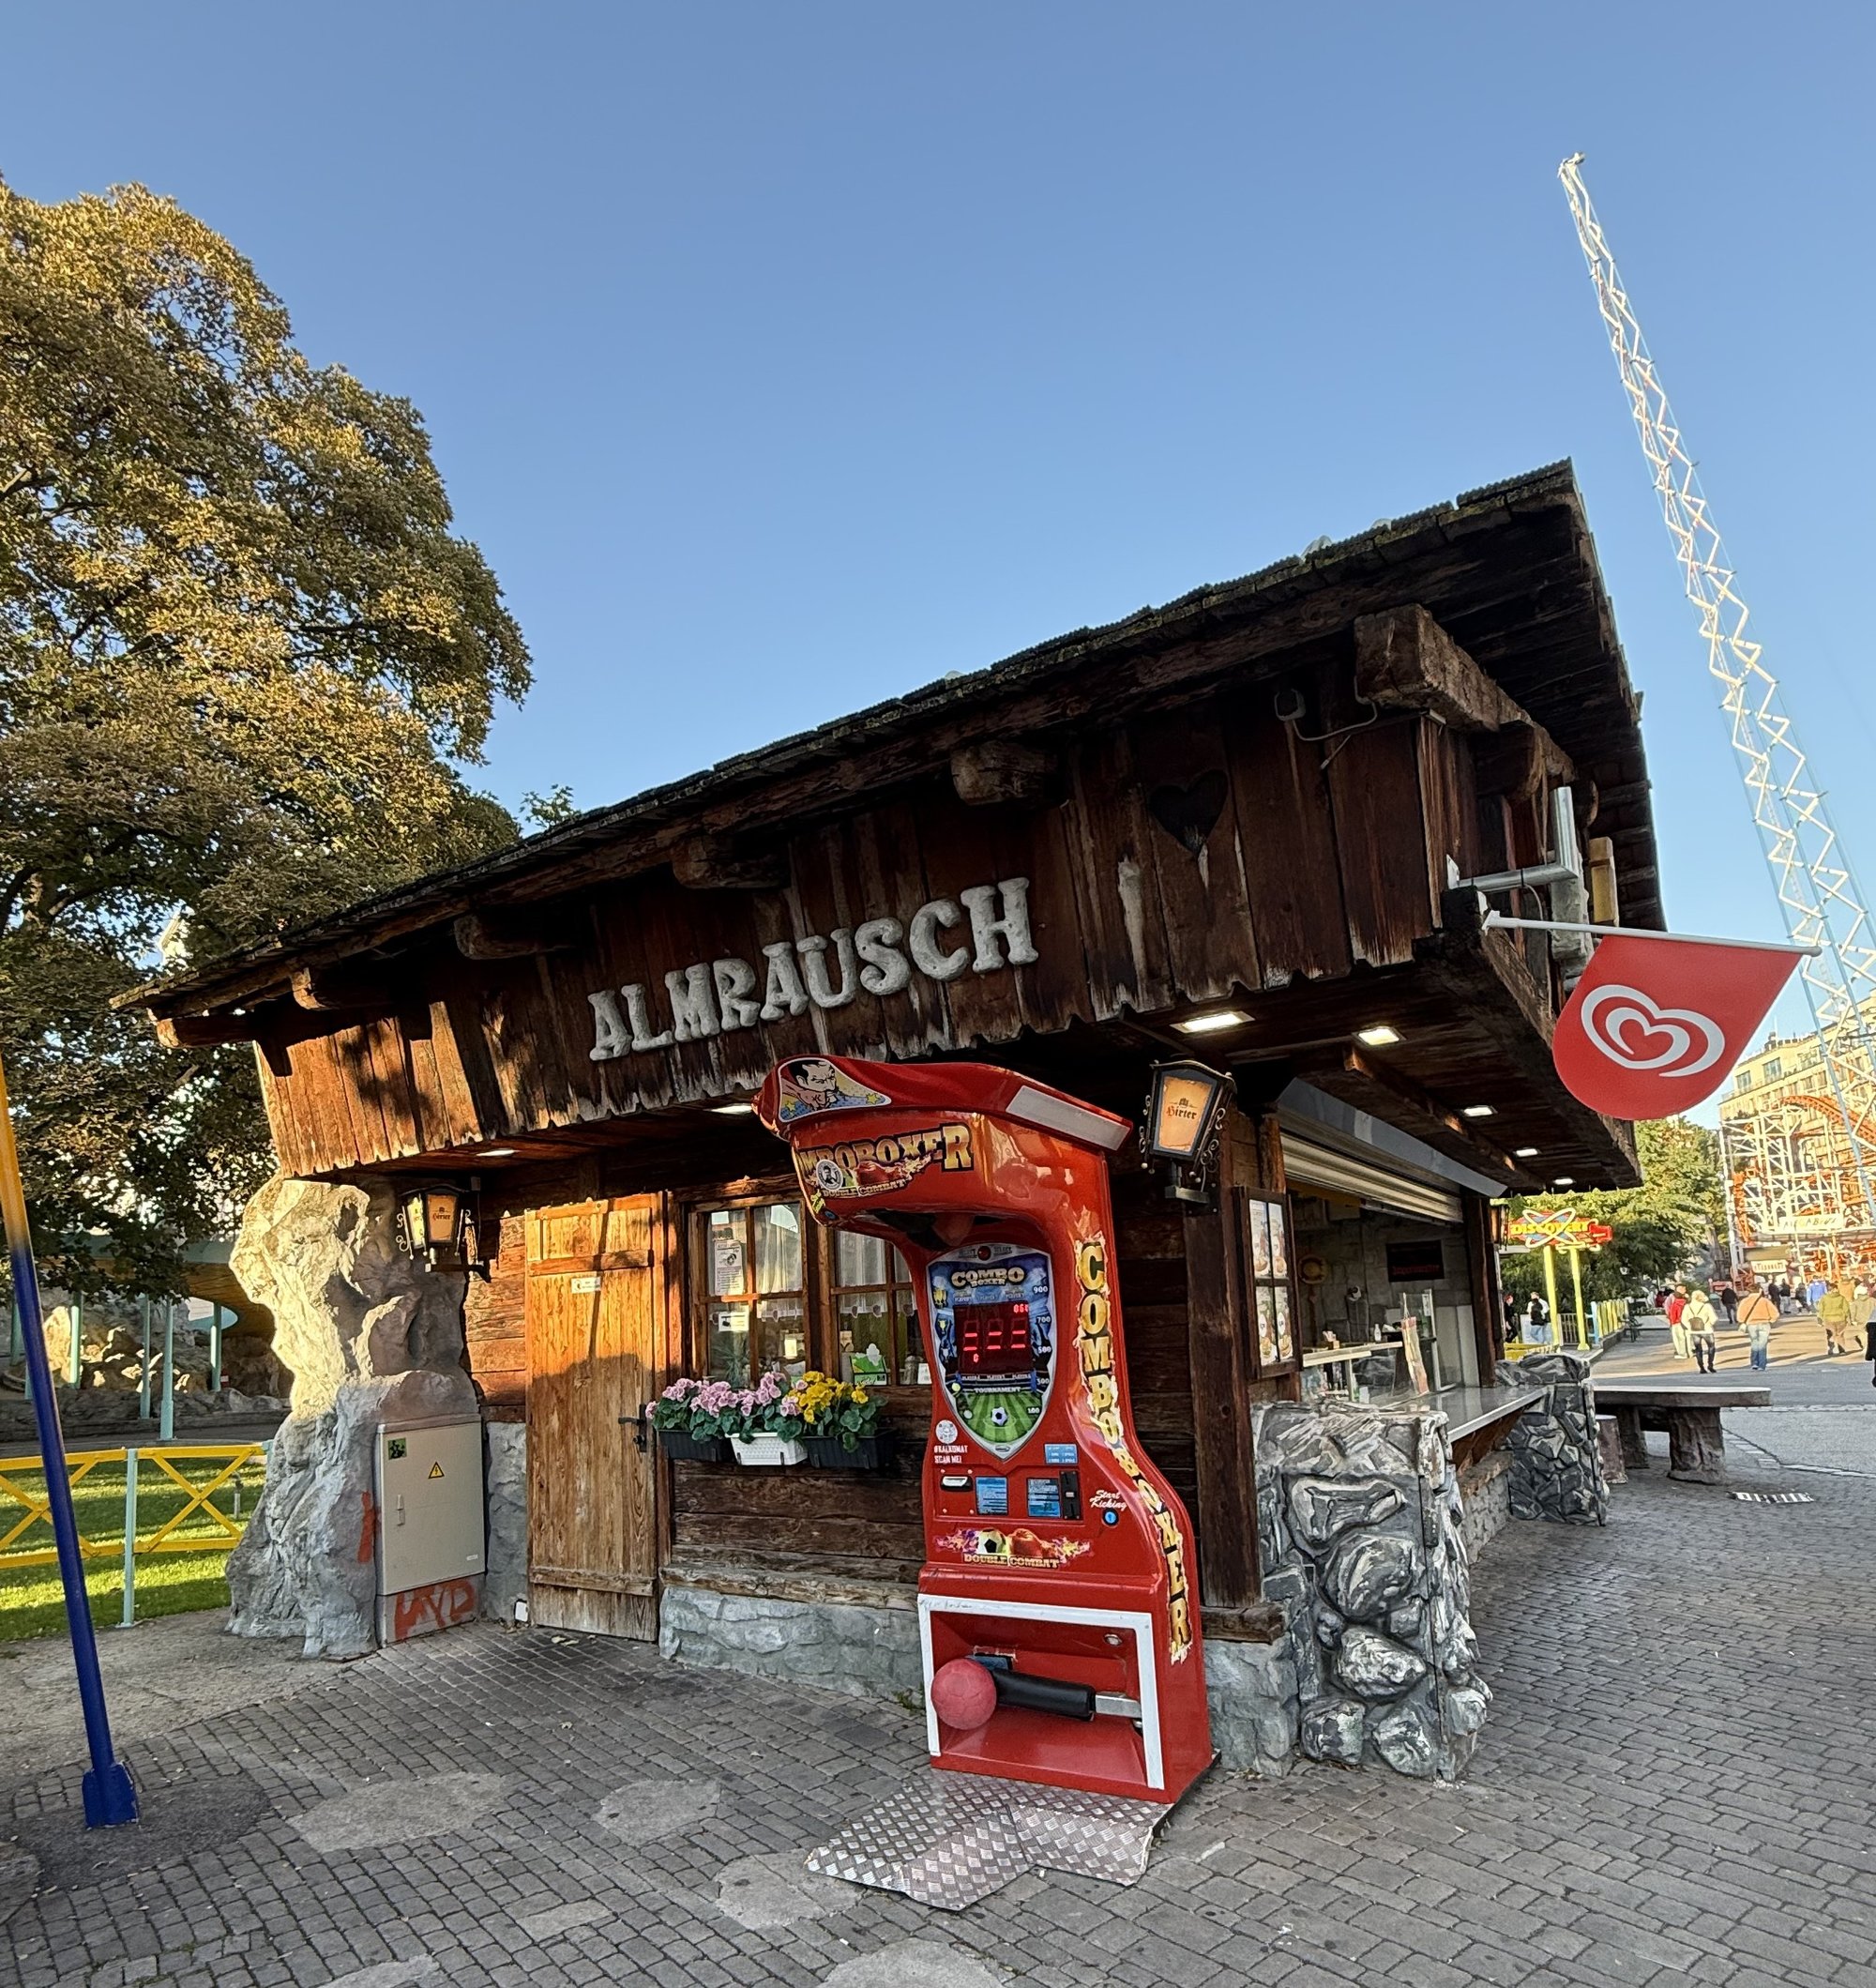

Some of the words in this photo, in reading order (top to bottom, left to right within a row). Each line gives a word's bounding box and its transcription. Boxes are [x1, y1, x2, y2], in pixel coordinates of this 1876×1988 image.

[588, 876, 1038, 1061] ALMRAUSCH
[859, 1179, 906, 1196] COMBAT
[951, 1267, 1025, 1288] COMBO
[970, 1277, 1006, 1287] BOXER
[1033, 1285, 1049, 1294] 900
[1037, 1315, 1051, 1324] 700
[1037, 1345, 1051, 1354] 500
[1036, 1377, 1050, 1386] 300
[934, 1455, 950, 1464] SCAN
[1094, 1489, 1121, 1500] Start
[1089, 1497, 1127, 1510] Kicking
[963, 1554, 1007, 1565] DOUBLE
[1009, 1555, 1060, 1568] COMBAT
